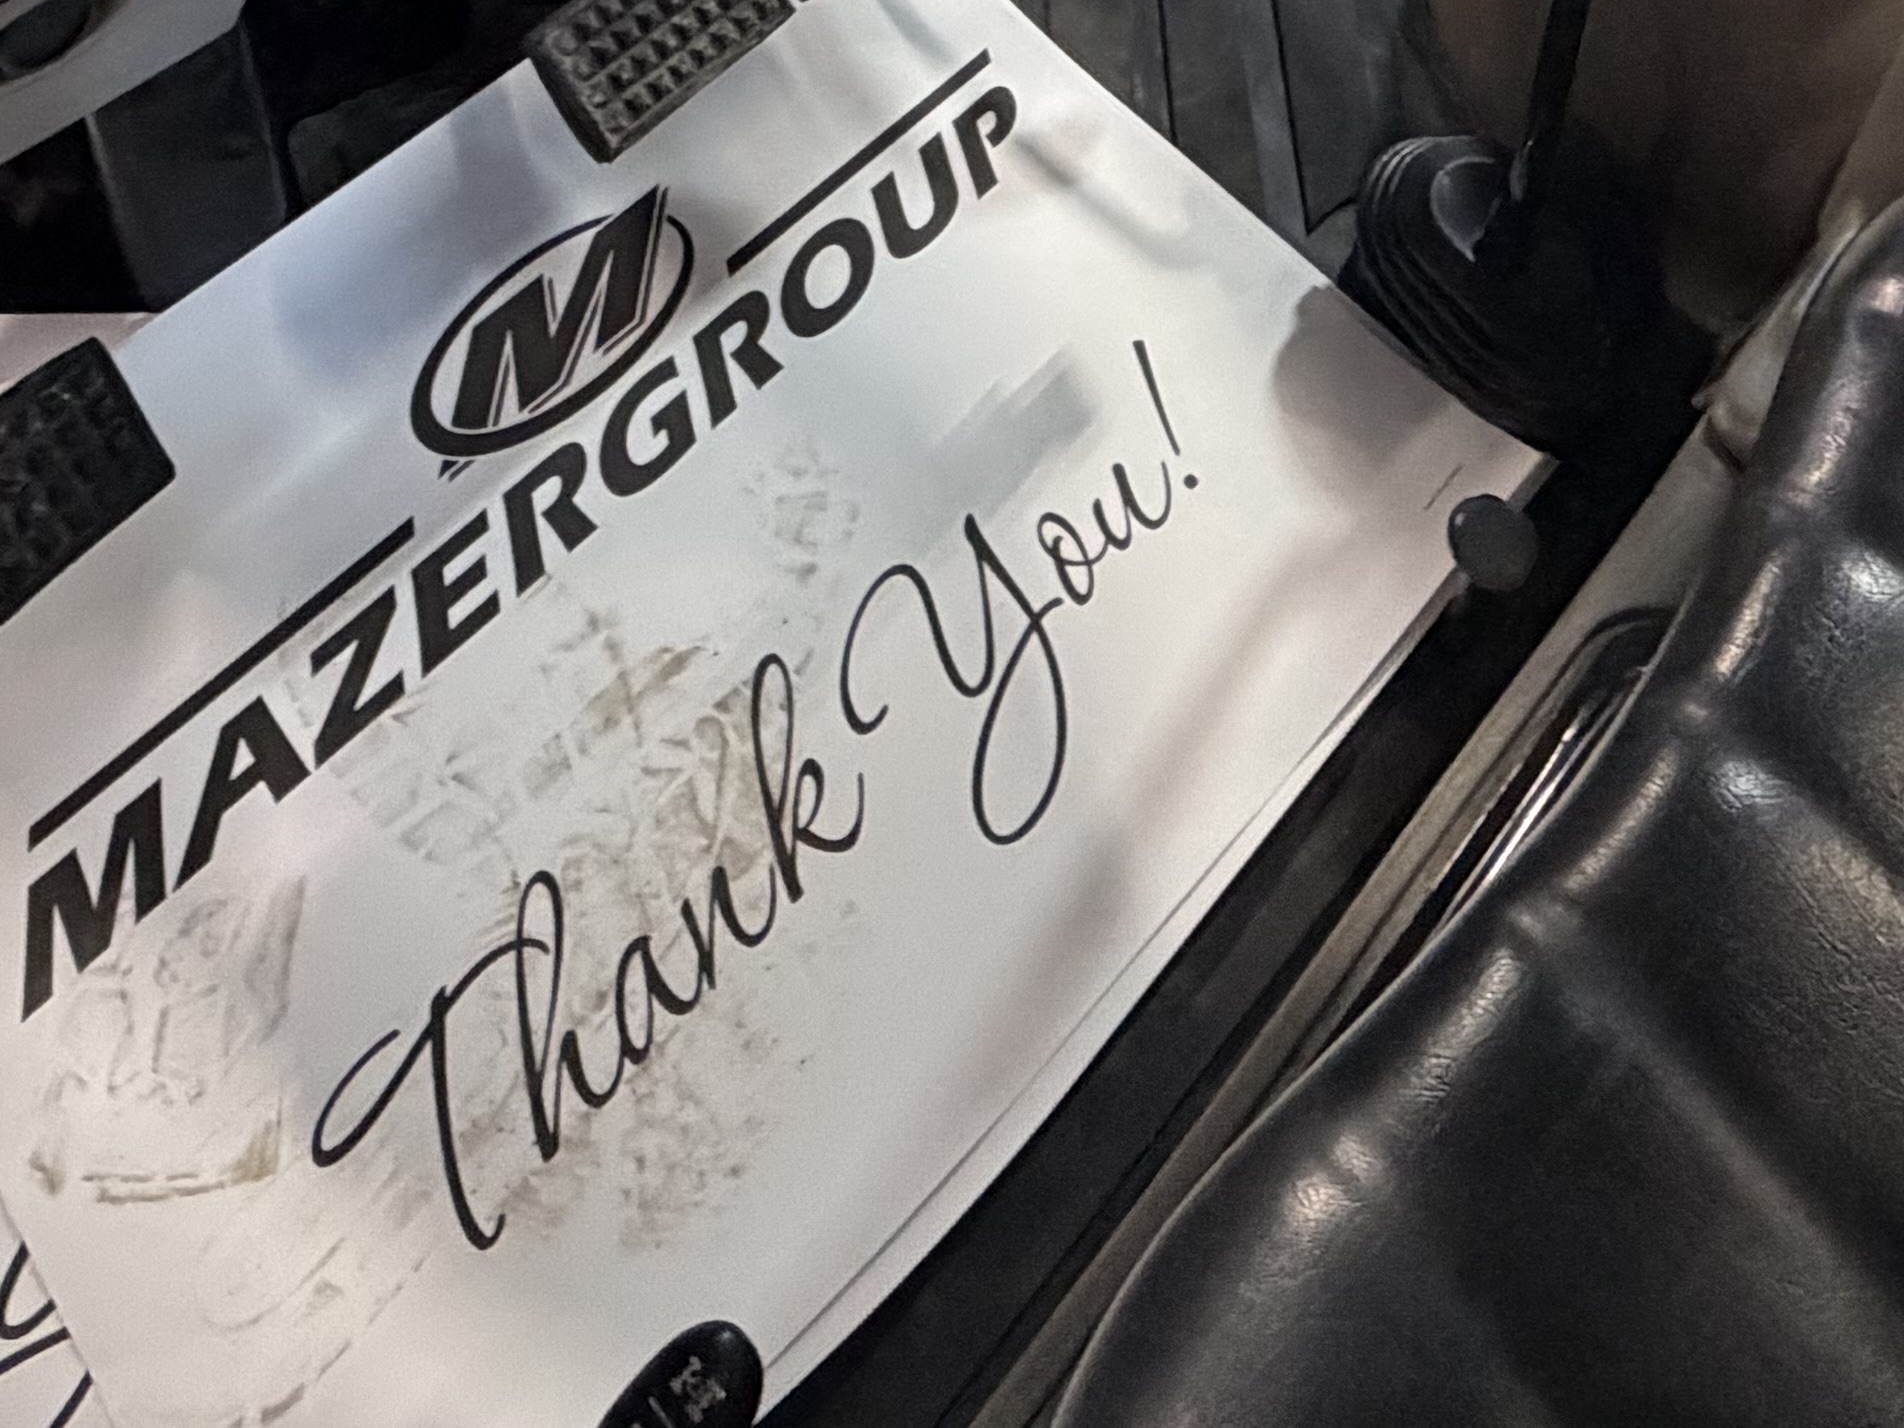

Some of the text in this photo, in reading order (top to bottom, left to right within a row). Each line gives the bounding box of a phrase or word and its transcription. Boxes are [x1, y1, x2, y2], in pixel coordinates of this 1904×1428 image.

[21, 85, 1018, 1022] MAZERGROUP
[310, 339, 1200, 1251] Thank You!
